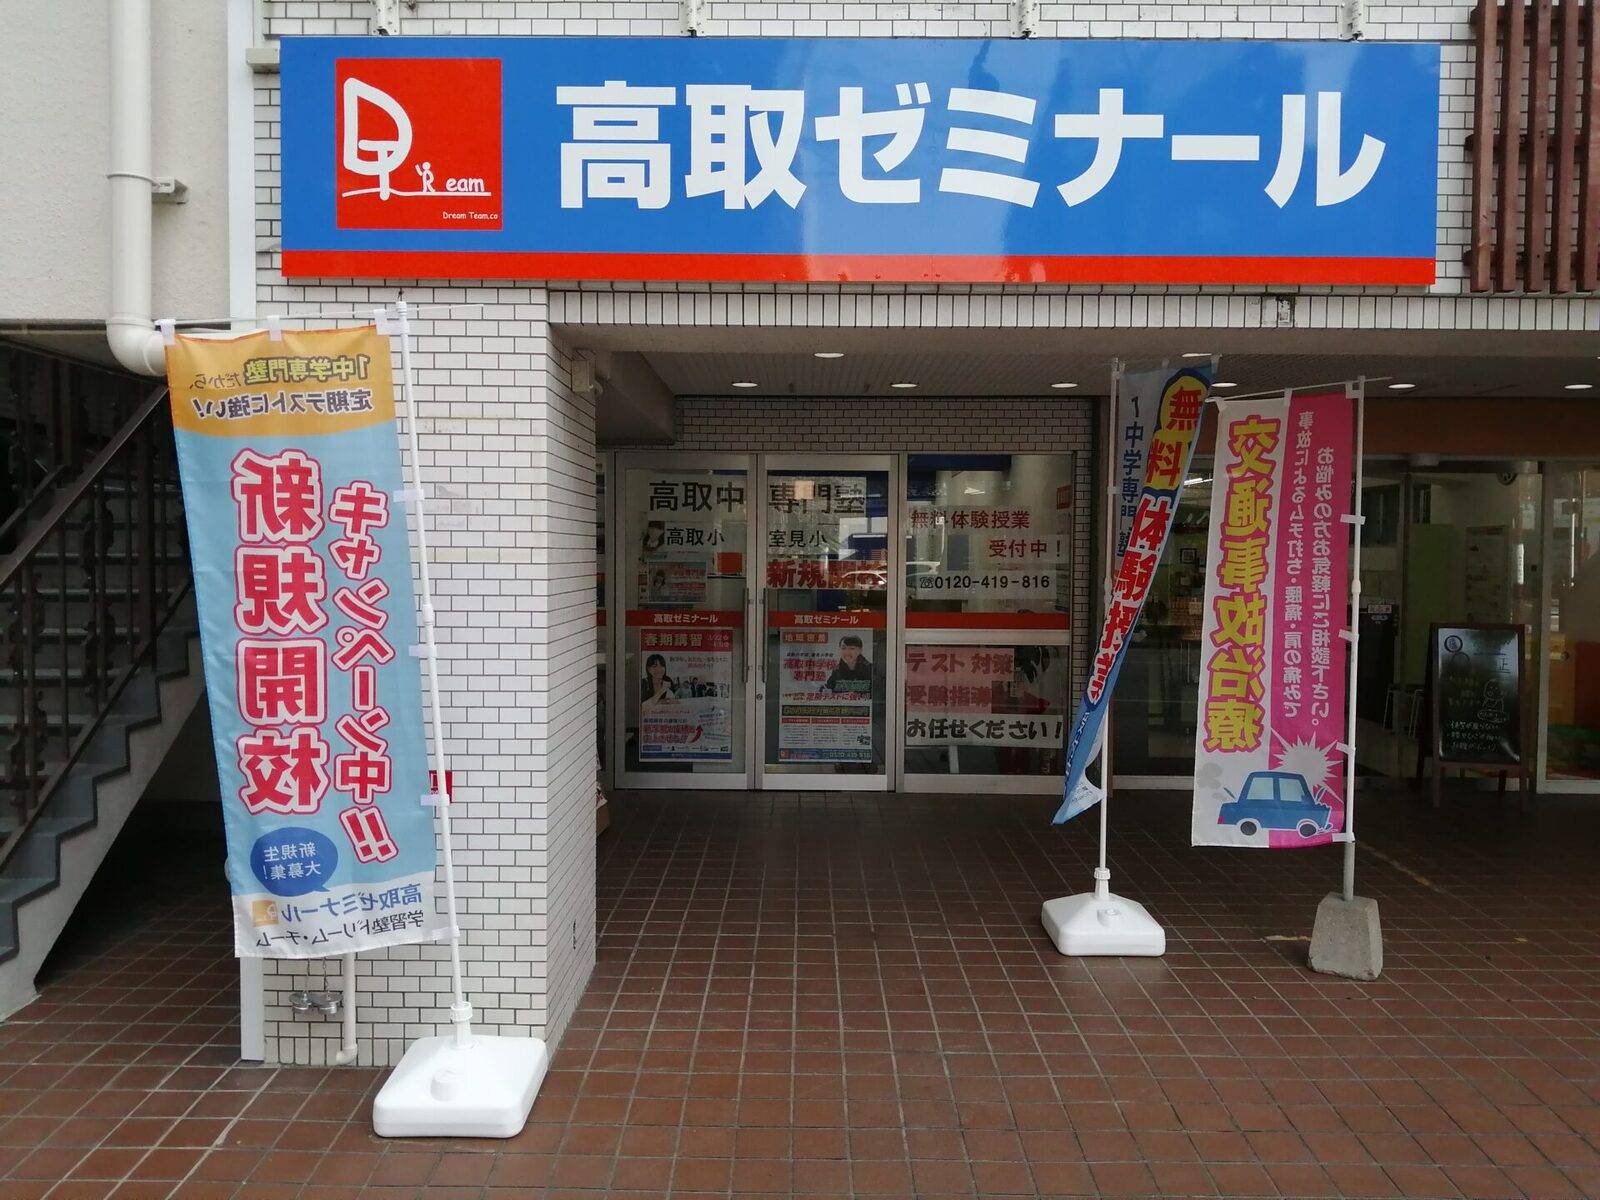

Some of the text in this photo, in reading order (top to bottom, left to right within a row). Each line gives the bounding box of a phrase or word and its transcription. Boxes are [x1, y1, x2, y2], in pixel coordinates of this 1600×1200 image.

[556, 81, 1386, 210] 高取ゼミナール
[443, 211, 466, 220] Dream
[649, 480, 744, 513] 高取中
[911, 510, 1030, 529] 無料体験授業
[667, 528, 827, 547] 高取小 室見小
[989, 540, 1061, 558] 受付中!
[935, 575, 1050, 589] 0120-419-816
[654, 613, 719, 624] 高取ゼミナール
[794, 614, 859, 624] 高取ゼミナール
[906, 685, 991, 707] 受験指導
[906, 719, 1062, 739] お任せください!
